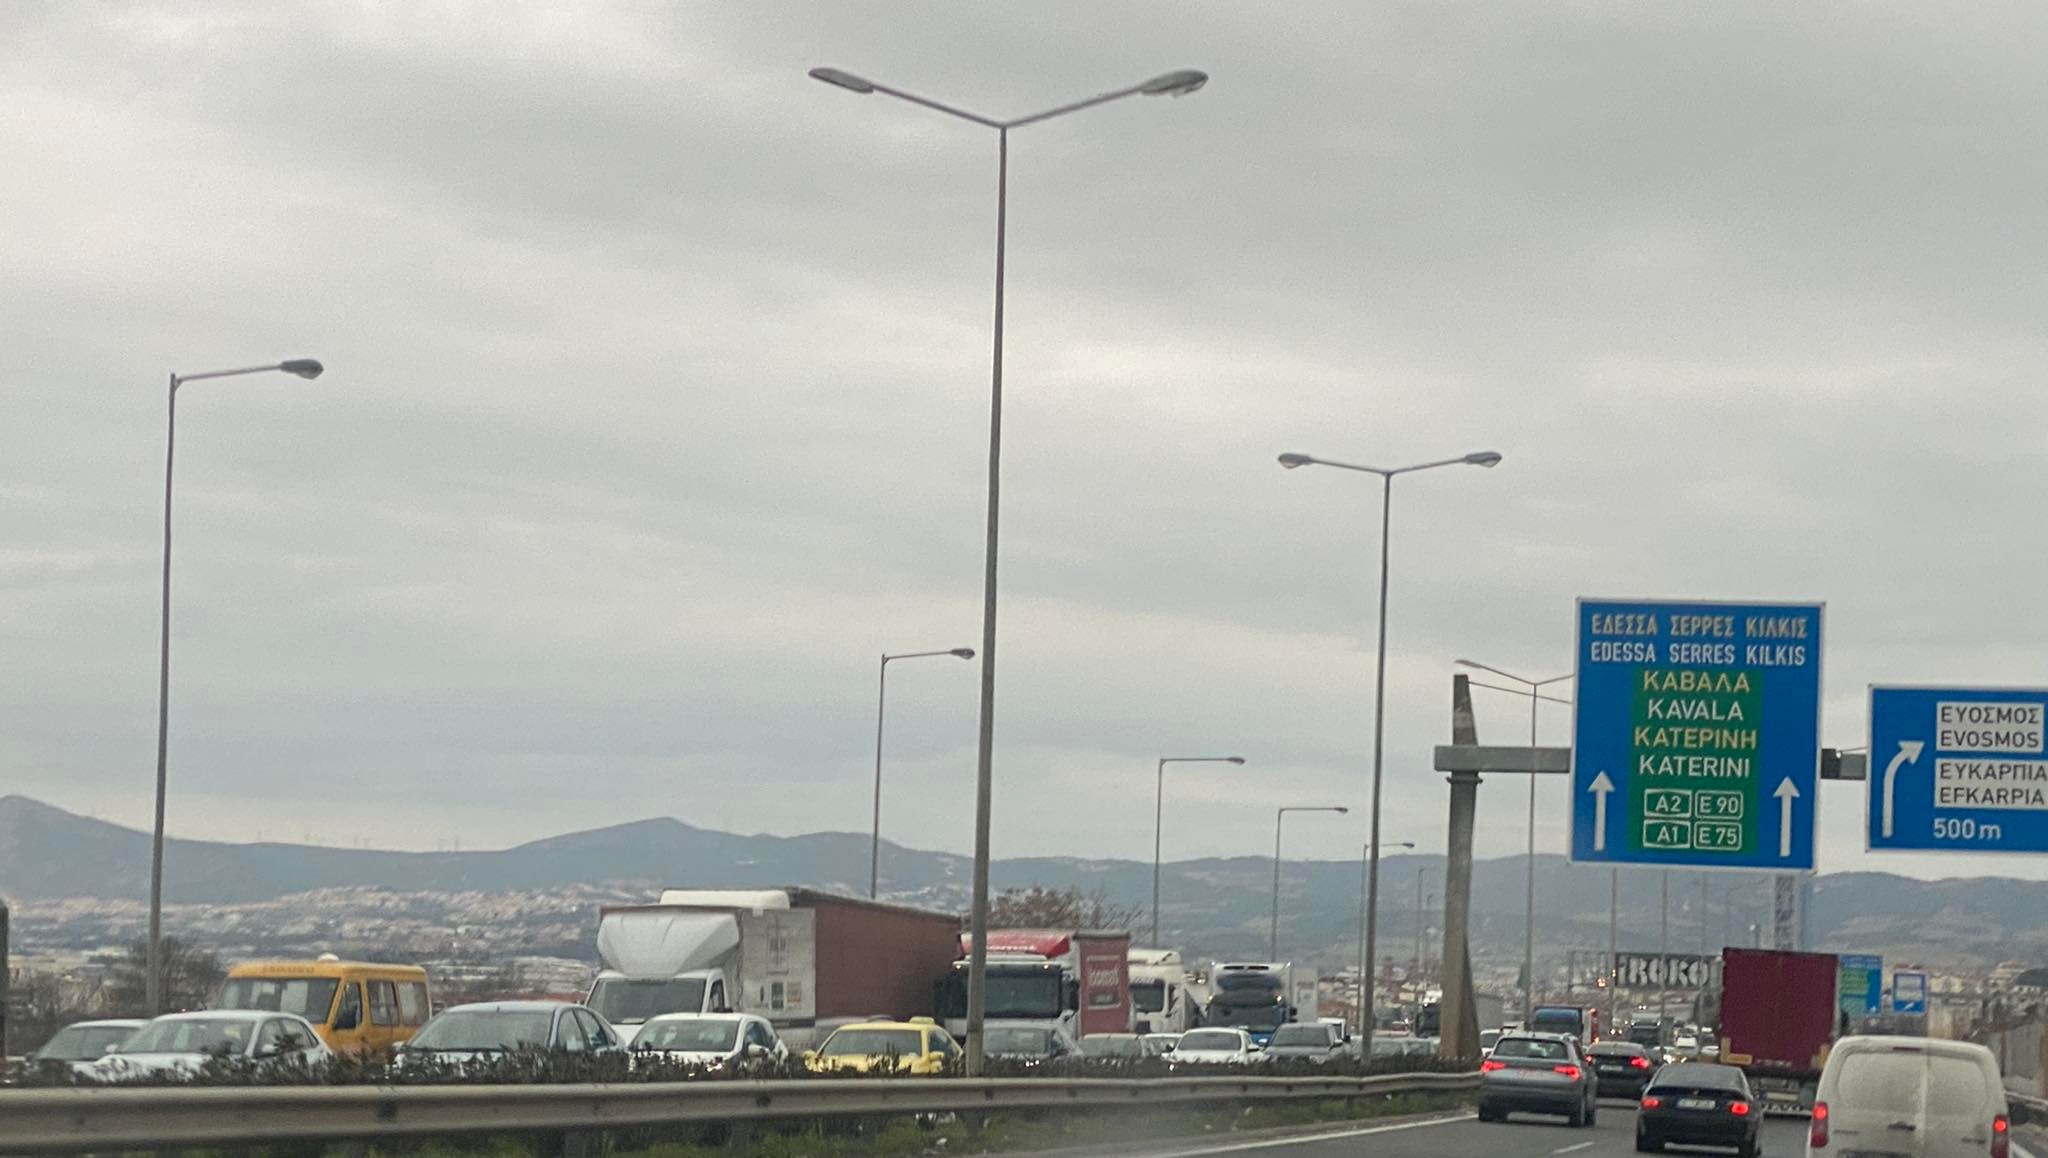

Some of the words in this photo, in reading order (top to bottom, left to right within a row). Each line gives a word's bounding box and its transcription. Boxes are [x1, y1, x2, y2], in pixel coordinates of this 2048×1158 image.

[1591, 613, 1658, 636] ΕΔΕΣΣΑ
[1670, 615, 1734, 637] ΣΕΡΡΕΣ
[1745, 616, 1809, 639] ΚΙΛΚΙΣ
[1591, 641, 1656, 663] EDESSA
[1669, 643, 1735, 664] SERRES
[1746, 645, 1805, 666] KILKIS
[1643, 670, 1750, 693] ΚΑΒΑΛΑ
[1648, 698, 1744, 721] KAVALA
[1941, 706, 2040, 724] ΕΥΟΣΜΟΣ
[1634, 727, 1757, 750] ΚΑΤΕΡΙΝΗ
[1940, 730, 2040, 748] EVOSMOS
[1639, 755, 1750, 778] KATERINI
[1940, 762, 2048, 781] ΕΥΚΑΡΠΙΑ
[1655, 796, 1681, 813] A2
[1699, 796, 1712, 813] E
[1717, 796, 1739, 813] 90
[1939, 786, 2045, 805] EFKARPIA
[1656, 825, 1679, 843] A1
[1698, 827, 1711, 844] E
[1716, 827, 1738, 845] 75
[1933, 818, 1975, 839] 500
[1979, 823, 2001, 840] m
